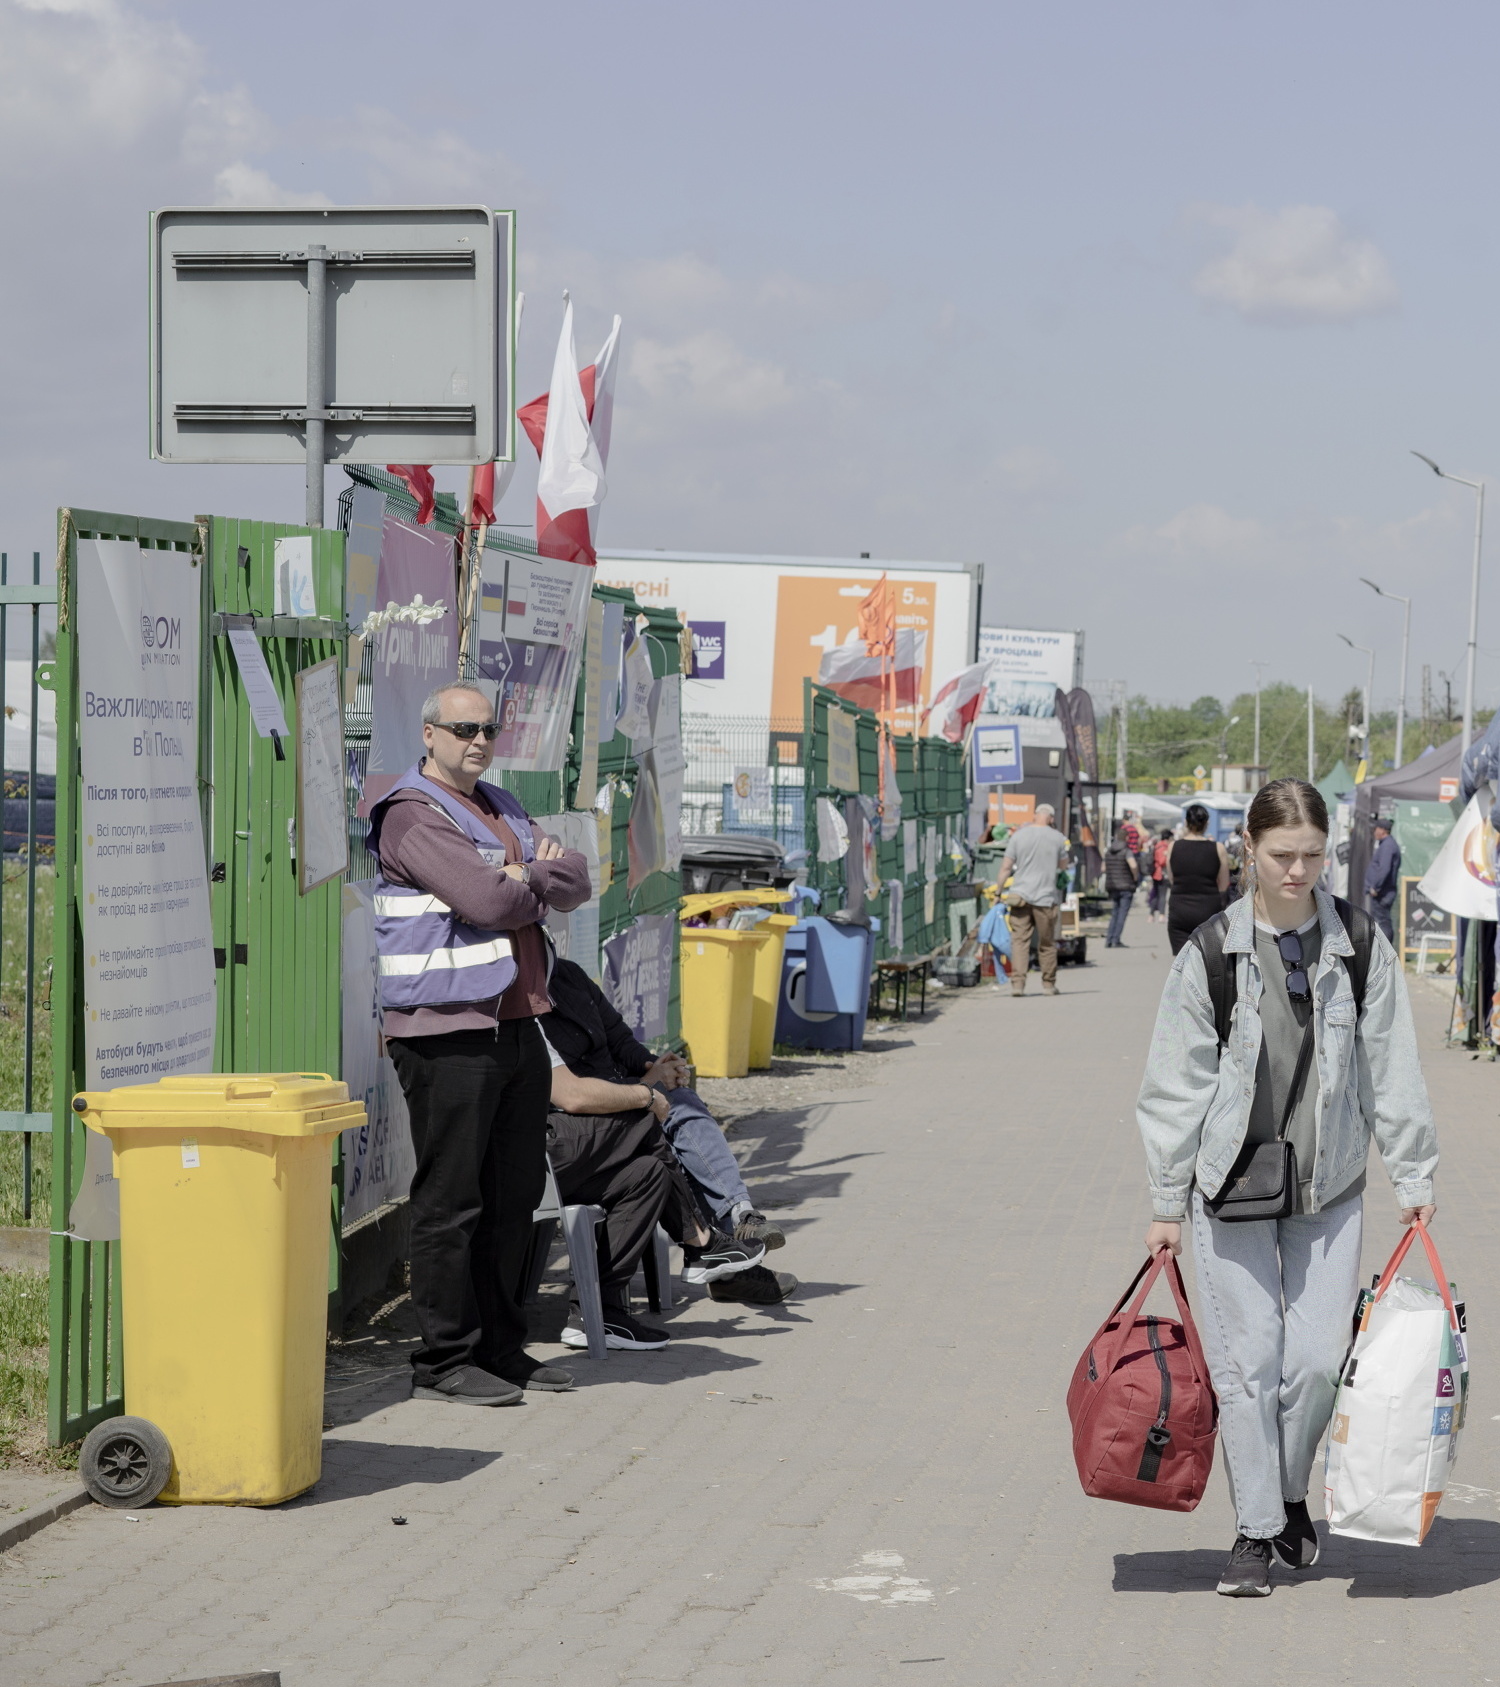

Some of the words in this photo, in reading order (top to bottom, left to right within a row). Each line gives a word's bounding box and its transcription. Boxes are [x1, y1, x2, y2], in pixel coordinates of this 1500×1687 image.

[903, 588, 914, 603] 5
[699, 635, 723, 648] WC
[1012, 636, 1060, 644] КУЛЬТУРИ
[993, 648, 1042, 657] ВРОЦЛАВІ
[88, 785, 117, 800] Після
[122, 788, 148, 802] того,
[97, 824, 109, 836] Всі
[112, 825, 147, 839] послуги,
[97, 842, 133, 858] доступні
[136, 844, 150, 854] вам
[98, 884, 109, 898] Не
[111, 882, 151, 898] довіряйте
[98, 906, 108, 916] як
[110, 902, 135, 918] проїзд
[139, 903, 148, 914] на
[100, 949, 110, 962] Не
[112, 946, 154, 964] приймайте
[100, 965, 147, 981] незнайомців
[101, 1008, 110, 1021] Не
[112, 1004, 142, 1021] давайте
[96, 1042, 133, 1060] Автобуси
[136, 1041, 163, 1057] будуть
[101, 1062, 149, 1080] безпечного
[152, 1059, 169, 1073] місця
